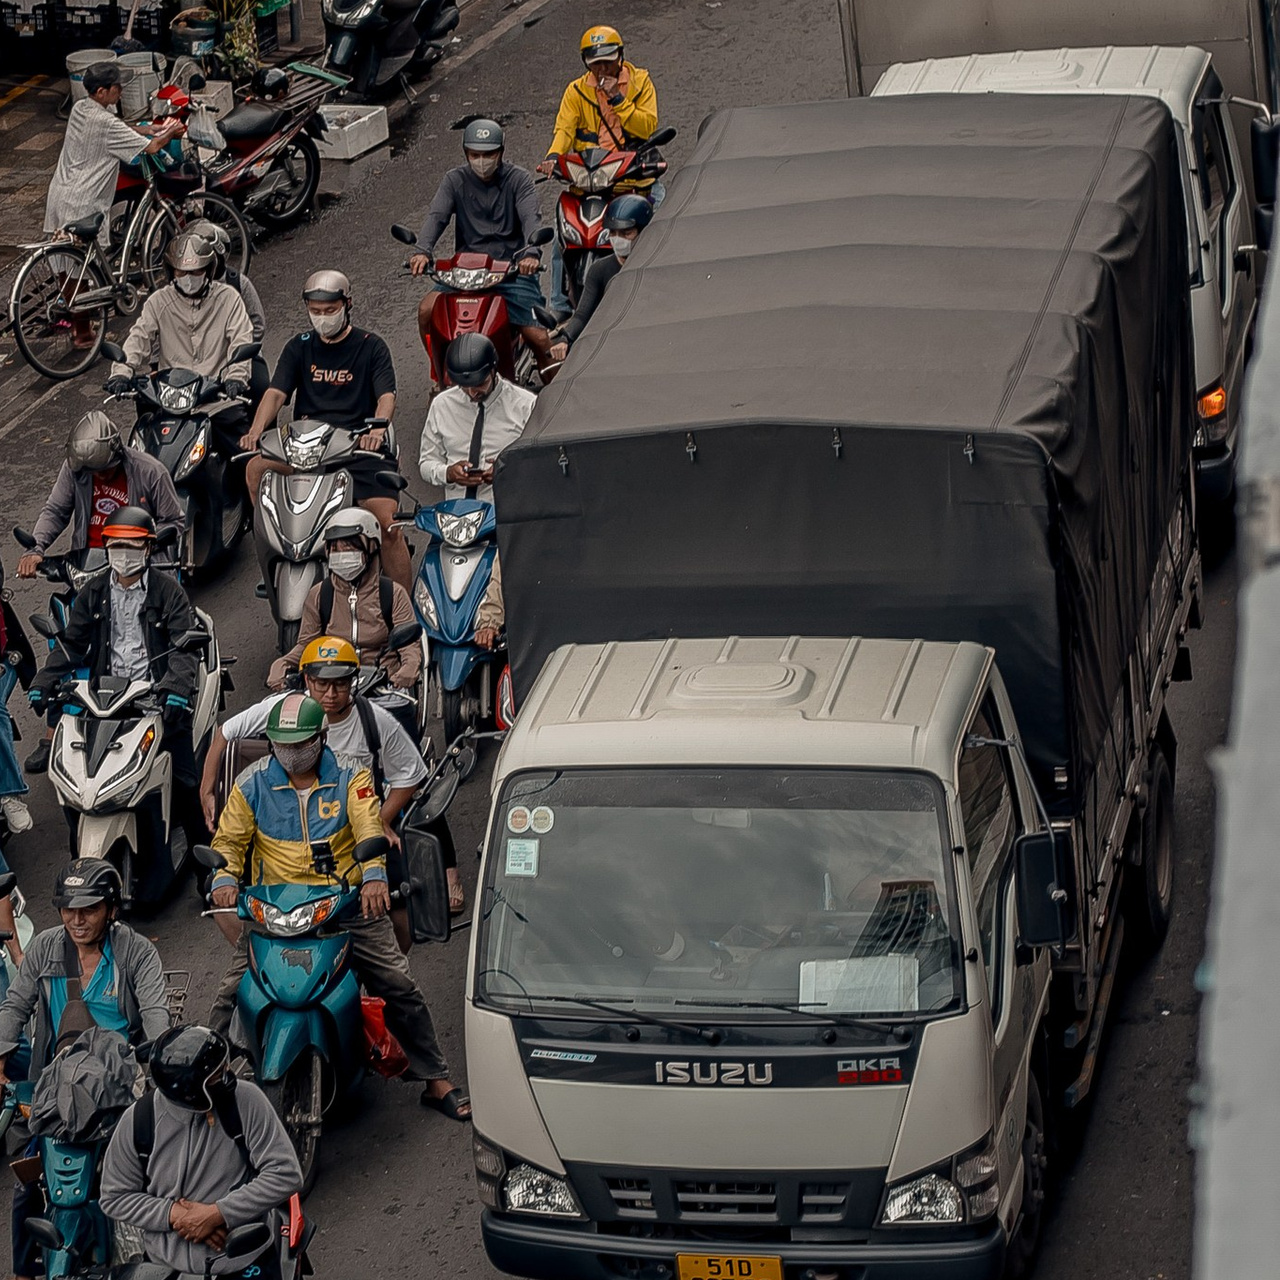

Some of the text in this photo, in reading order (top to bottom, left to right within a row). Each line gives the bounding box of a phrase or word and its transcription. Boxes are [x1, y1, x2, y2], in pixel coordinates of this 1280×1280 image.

[318, 646, 339, 658] be
[317, 796, 341, 820] be
[655, 1061, 773, 1085] ISUZU
[836, 1057, 901, 1072] QKR
[706, 1258, 752, 1277] 51D
